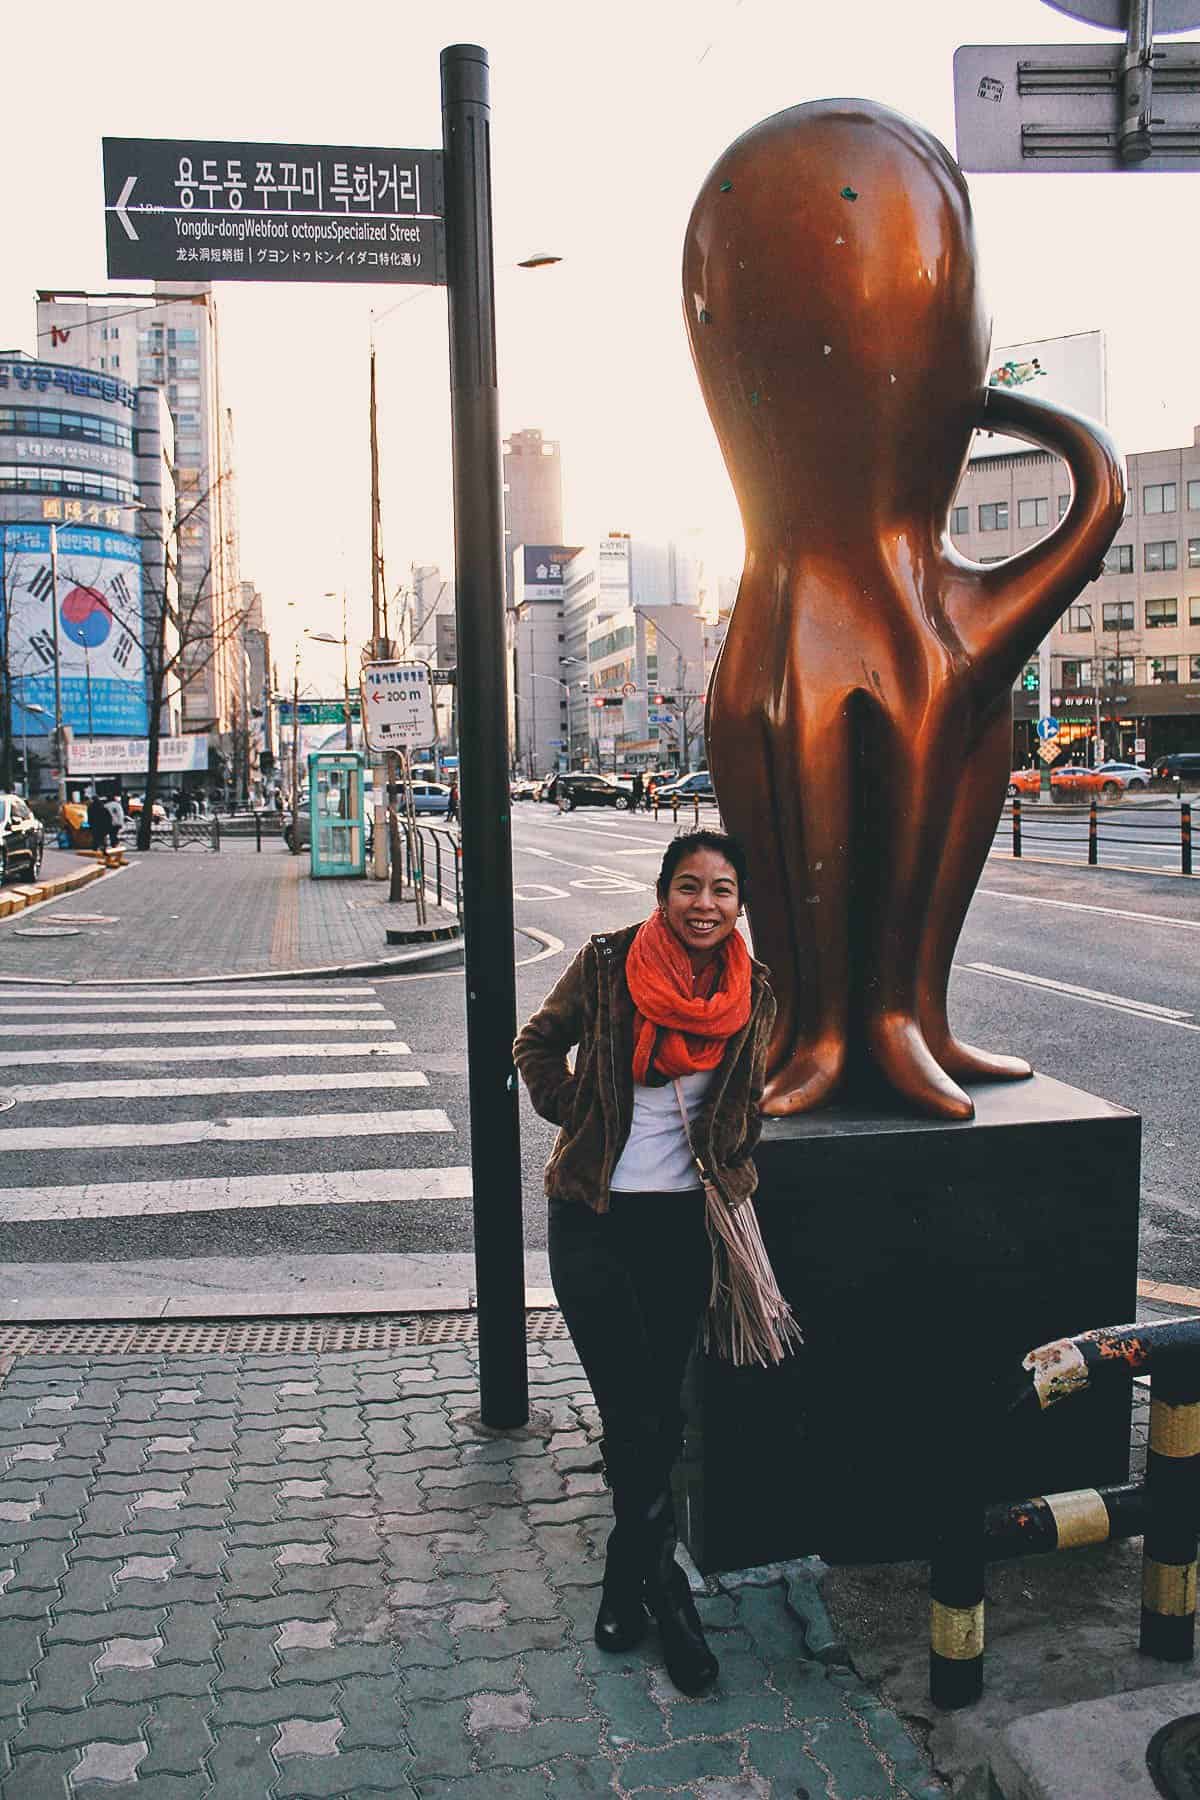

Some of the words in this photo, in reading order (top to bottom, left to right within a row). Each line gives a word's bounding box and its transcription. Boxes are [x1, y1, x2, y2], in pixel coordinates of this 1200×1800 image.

[174, 157, 248, 210] 용두동
[253, 161, 323, 210] 쭈꾸미
[329, 162, 421, 213] 특화거리
[389, 222, 421, 243] Street
[387, 690, 407, 701] 200
[409, 690, 421, 701] m
